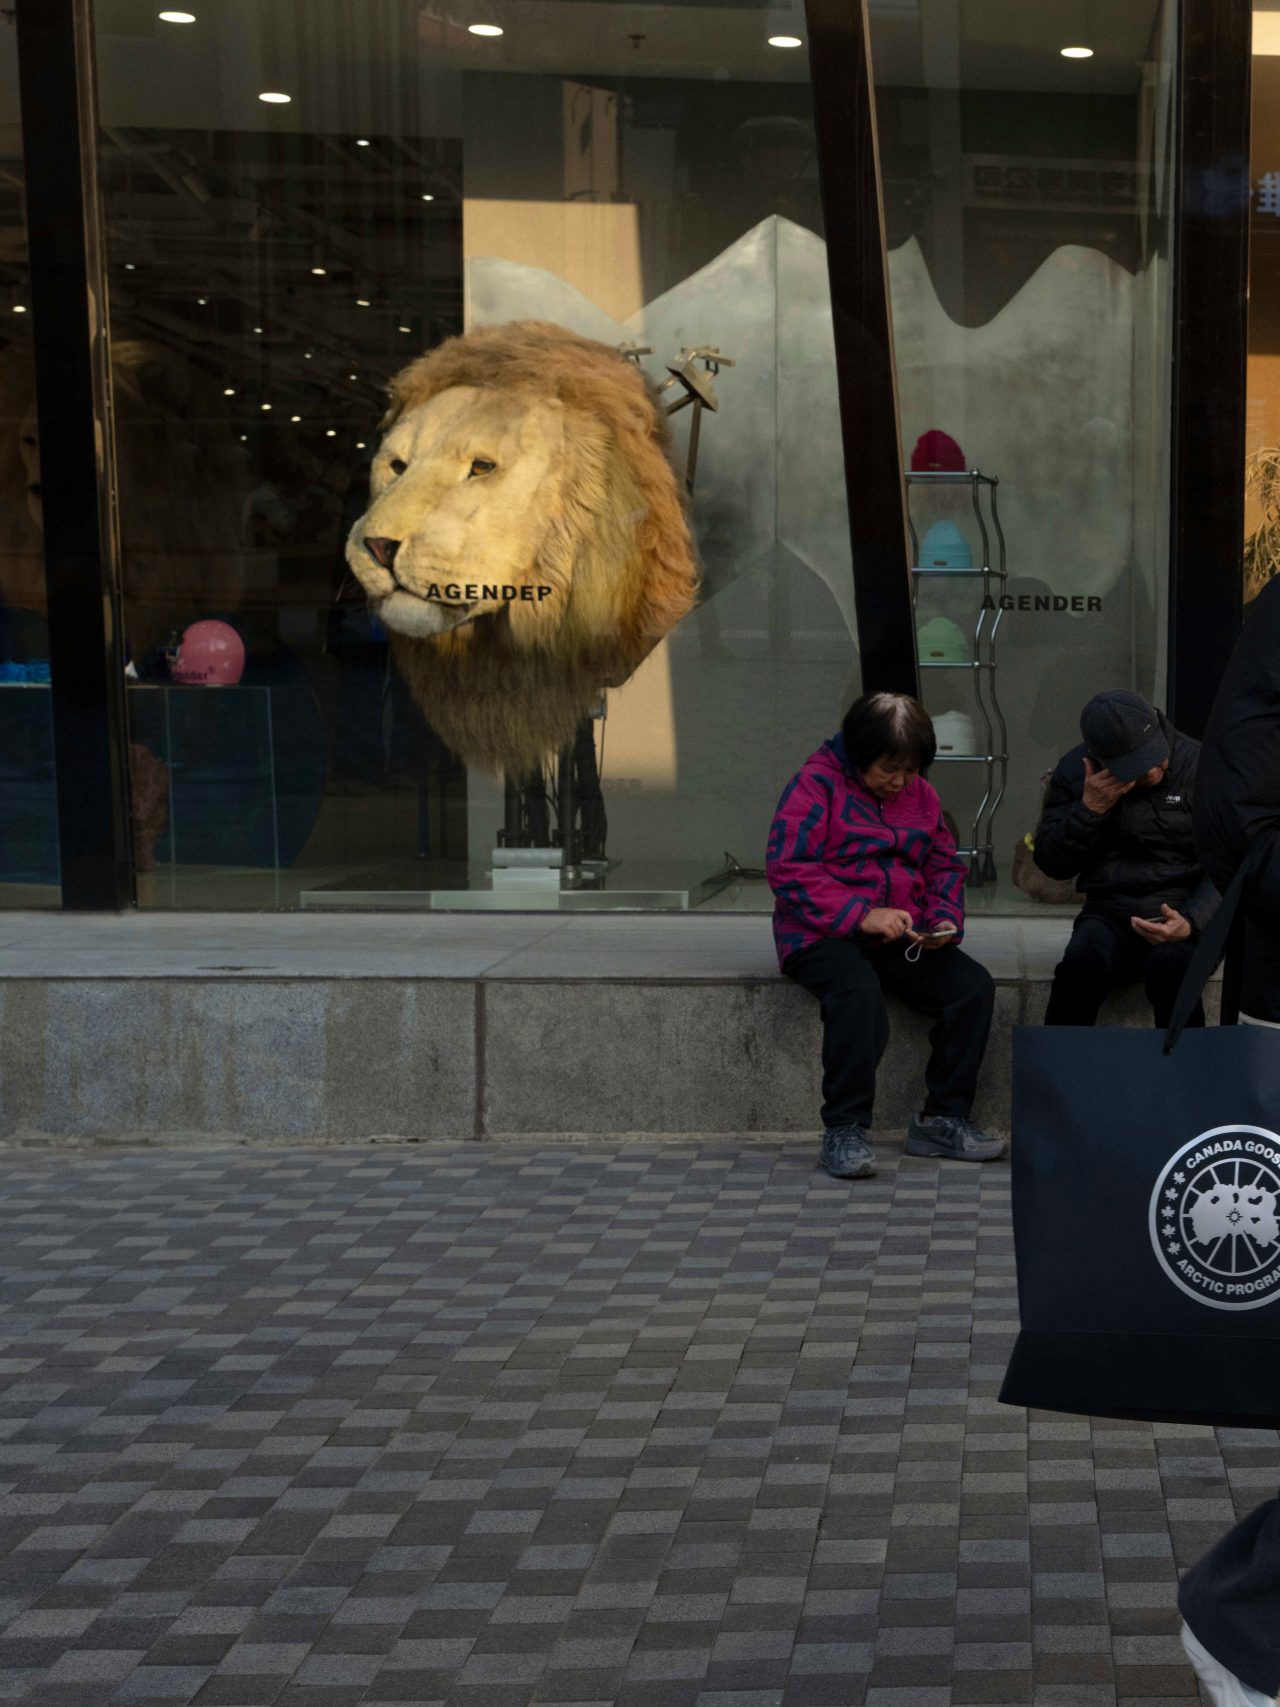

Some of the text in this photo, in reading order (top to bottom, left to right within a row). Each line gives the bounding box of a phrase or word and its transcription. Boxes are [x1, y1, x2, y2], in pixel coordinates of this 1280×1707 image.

[981, 594, 1102, 612] AGENDER
[1186, 1139, 1243, 1169] CANADA
[1176, 1259, 1225, 1294] ARCTIC
